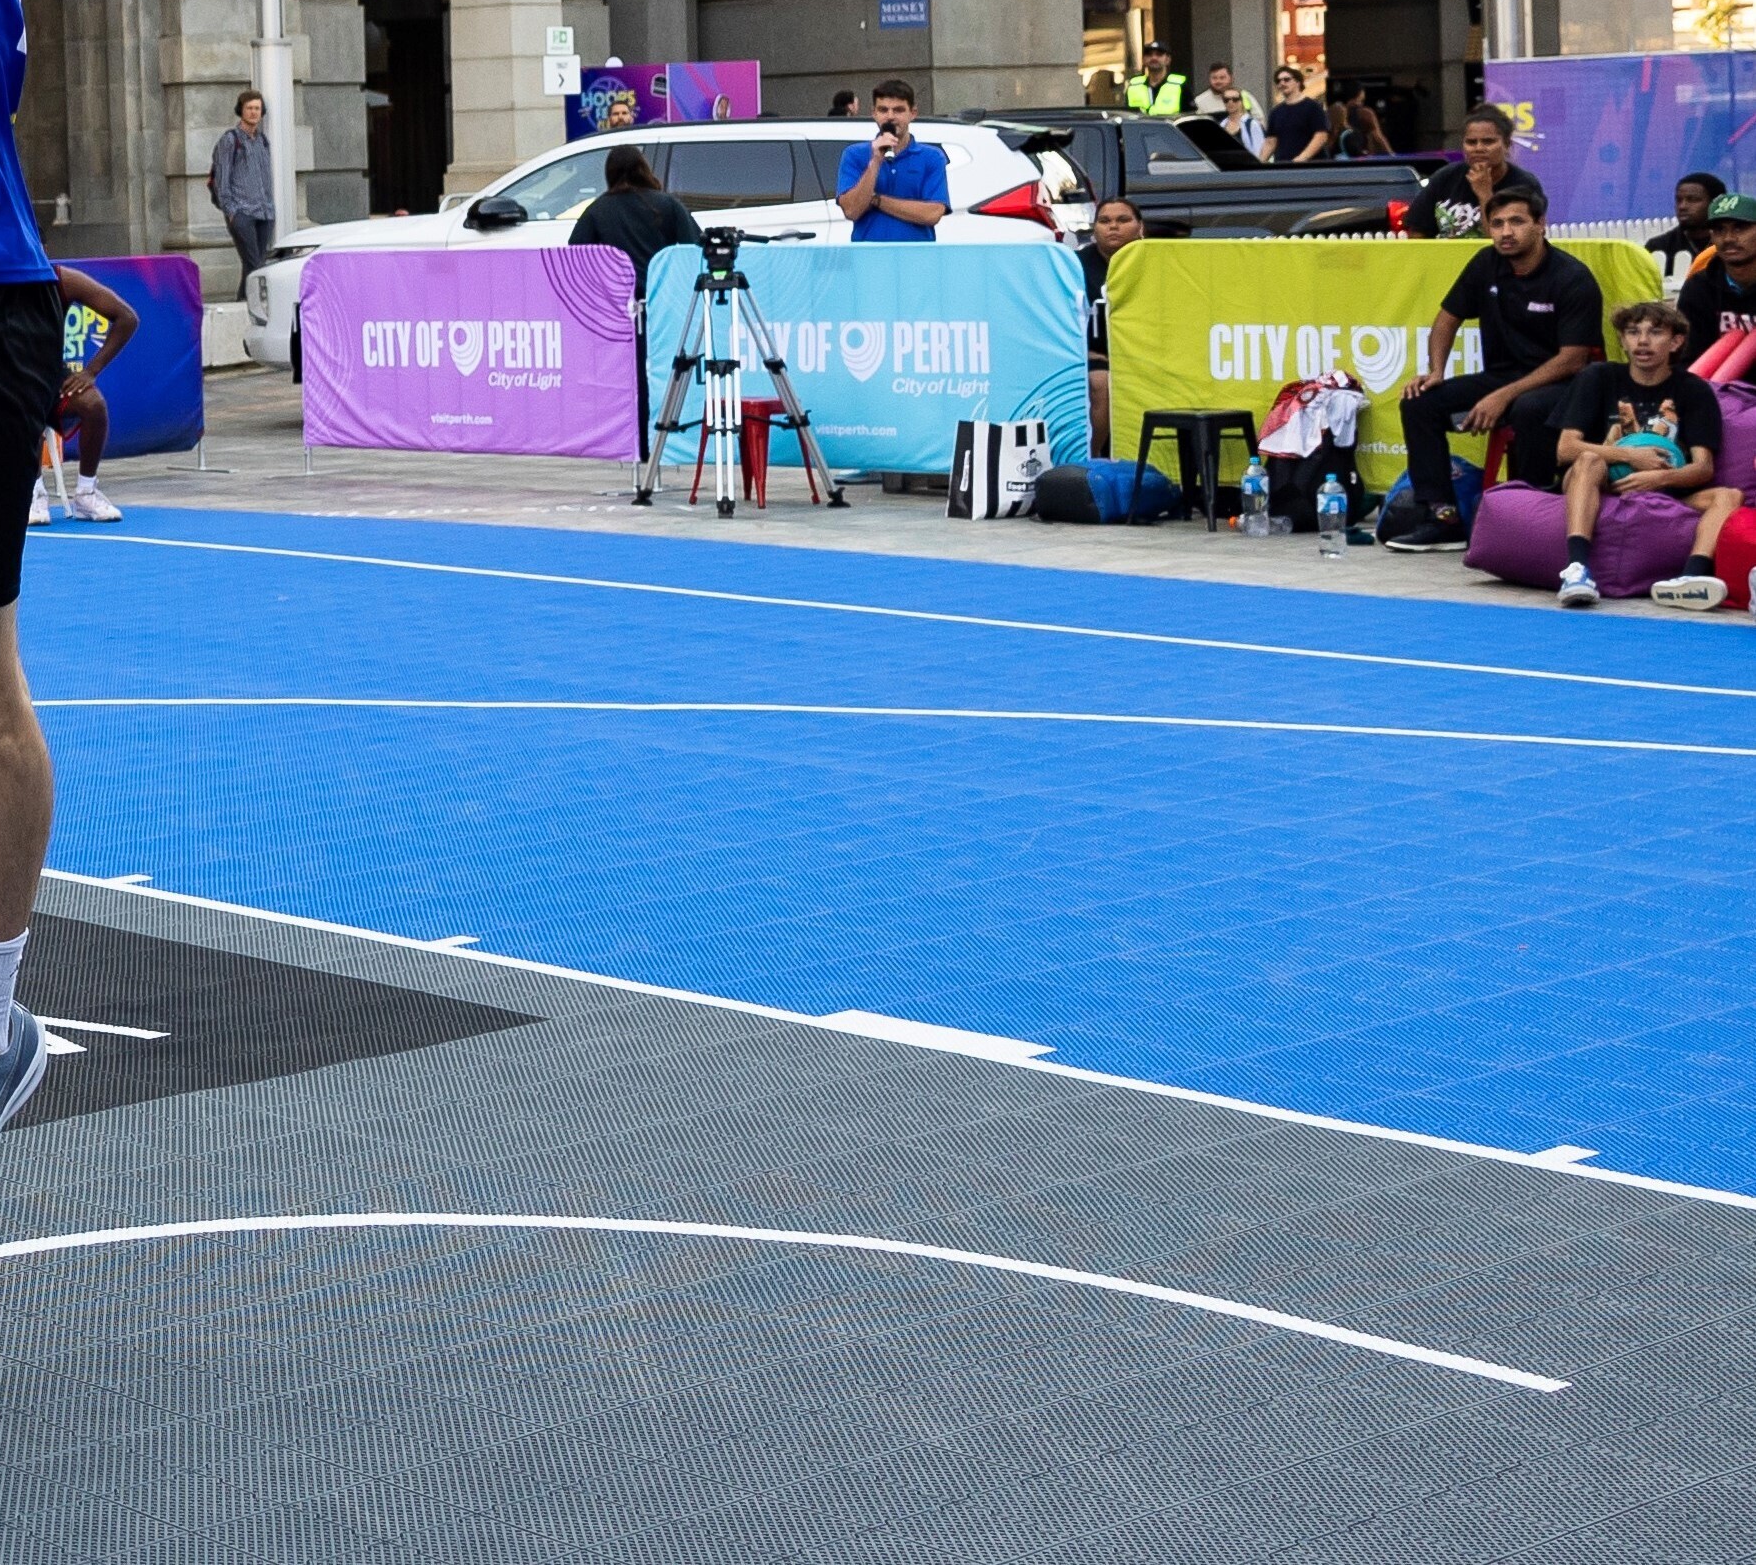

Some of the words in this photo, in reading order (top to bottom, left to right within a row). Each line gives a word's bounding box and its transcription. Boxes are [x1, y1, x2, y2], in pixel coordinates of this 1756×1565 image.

[882, 2, 924, 13] MONEY
[64, 305, 109, 334] OPS
[362, 321, 411, 368] CITY
[415, 321, 443, 368] OF
[487, 321, 562, 369] PERTH
[797, 321, 832, 373] OF
[893, 321, 989, 375] PERTH
[1209, 324, 1288, 380] CITY
[1296, 325, 1341, 380] OF
[487, 371, 514, 390] City
[514, 372, 530, 388] of
[529, 372, 562, 391] Light
[892, 377, 927, 396] City
[927, 377, 947, 395] of
[946, 378, 990, 398] Light
[430, 412, 493, 426] visitperth.com
[814, 424, 897, 437] visitperth.com
